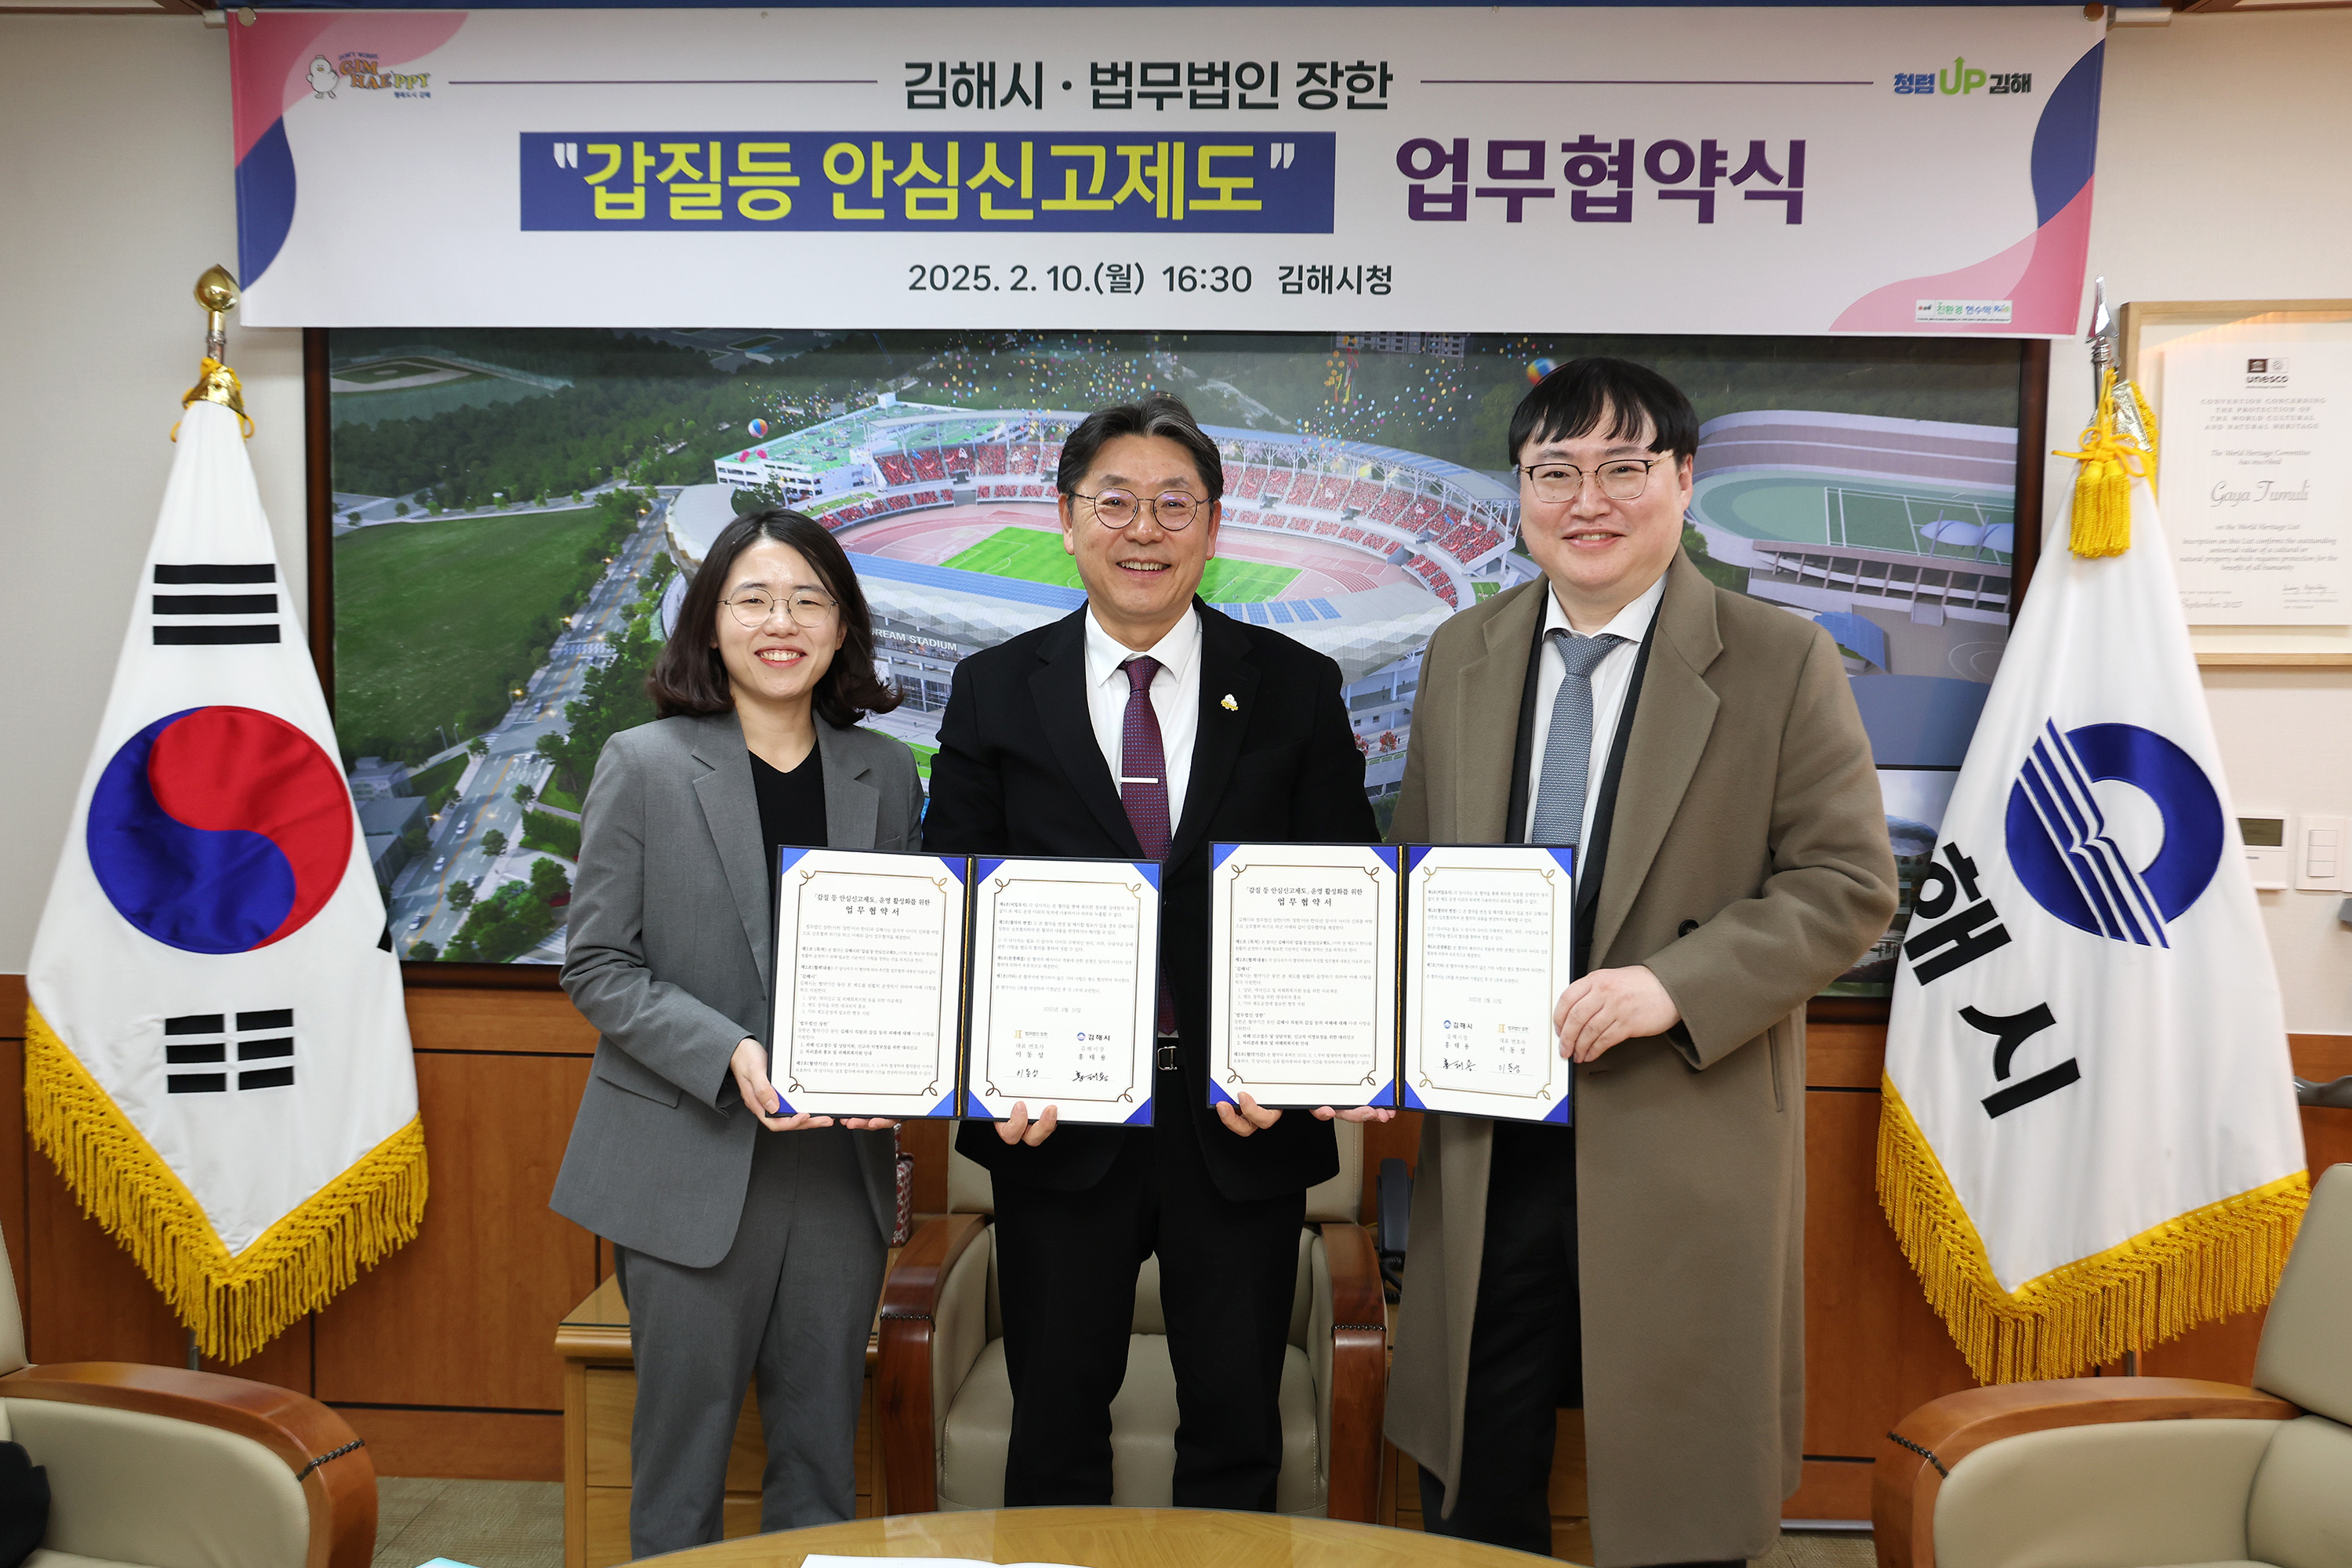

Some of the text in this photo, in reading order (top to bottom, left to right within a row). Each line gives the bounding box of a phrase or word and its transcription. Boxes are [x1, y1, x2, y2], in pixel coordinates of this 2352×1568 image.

[339, 60, 378, 75] GIM
[1894, 56, 2032, 95] 청렴 UP 김해
[904, 60, 1393, 111] 김해시 법무법인 장한
[1396, 134, 1806, 225] 업무협약식
[909, 262, 1392, 296] 2025. 2. 10.(월) 16:30 김해시청
[2210, 479, 2311, 507] Gaya Tumuli
[909, 635, 956, 651] STADIUM
